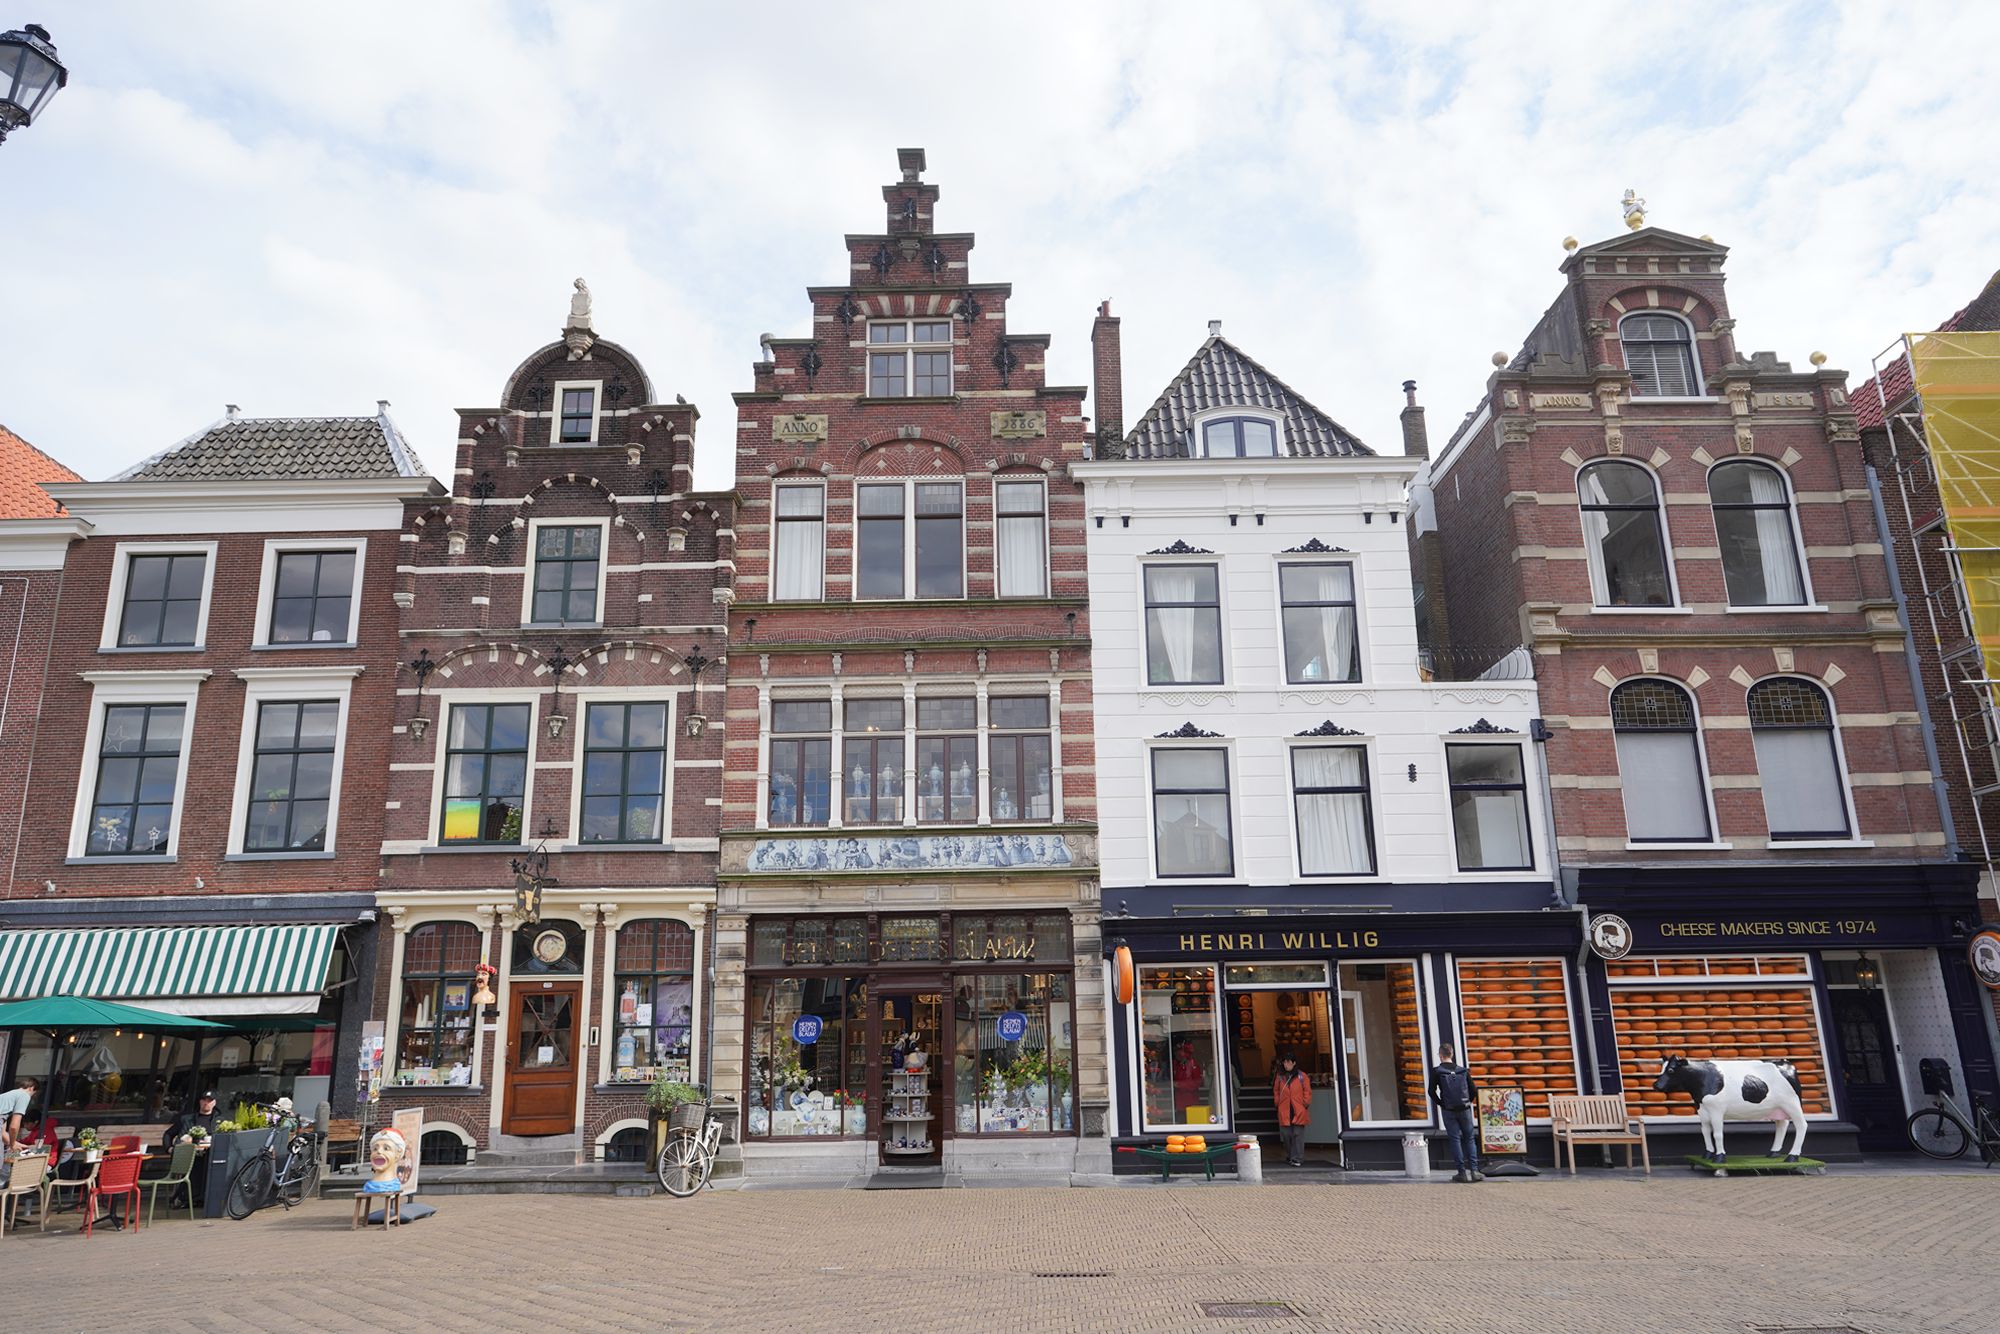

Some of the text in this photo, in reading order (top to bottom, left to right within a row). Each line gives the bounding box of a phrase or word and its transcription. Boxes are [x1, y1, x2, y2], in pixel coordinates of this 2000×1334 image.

[1543, 395, 1581, 407] ANNO
[1763, 394, 1804, 406] 1887
[782, 421, 818, 433] ANNO
[1660, 920, 1876, 937] CHEESE MAKERS SINCE 1974
[1180, 931, 1379, 951] HENRI WILLIG
